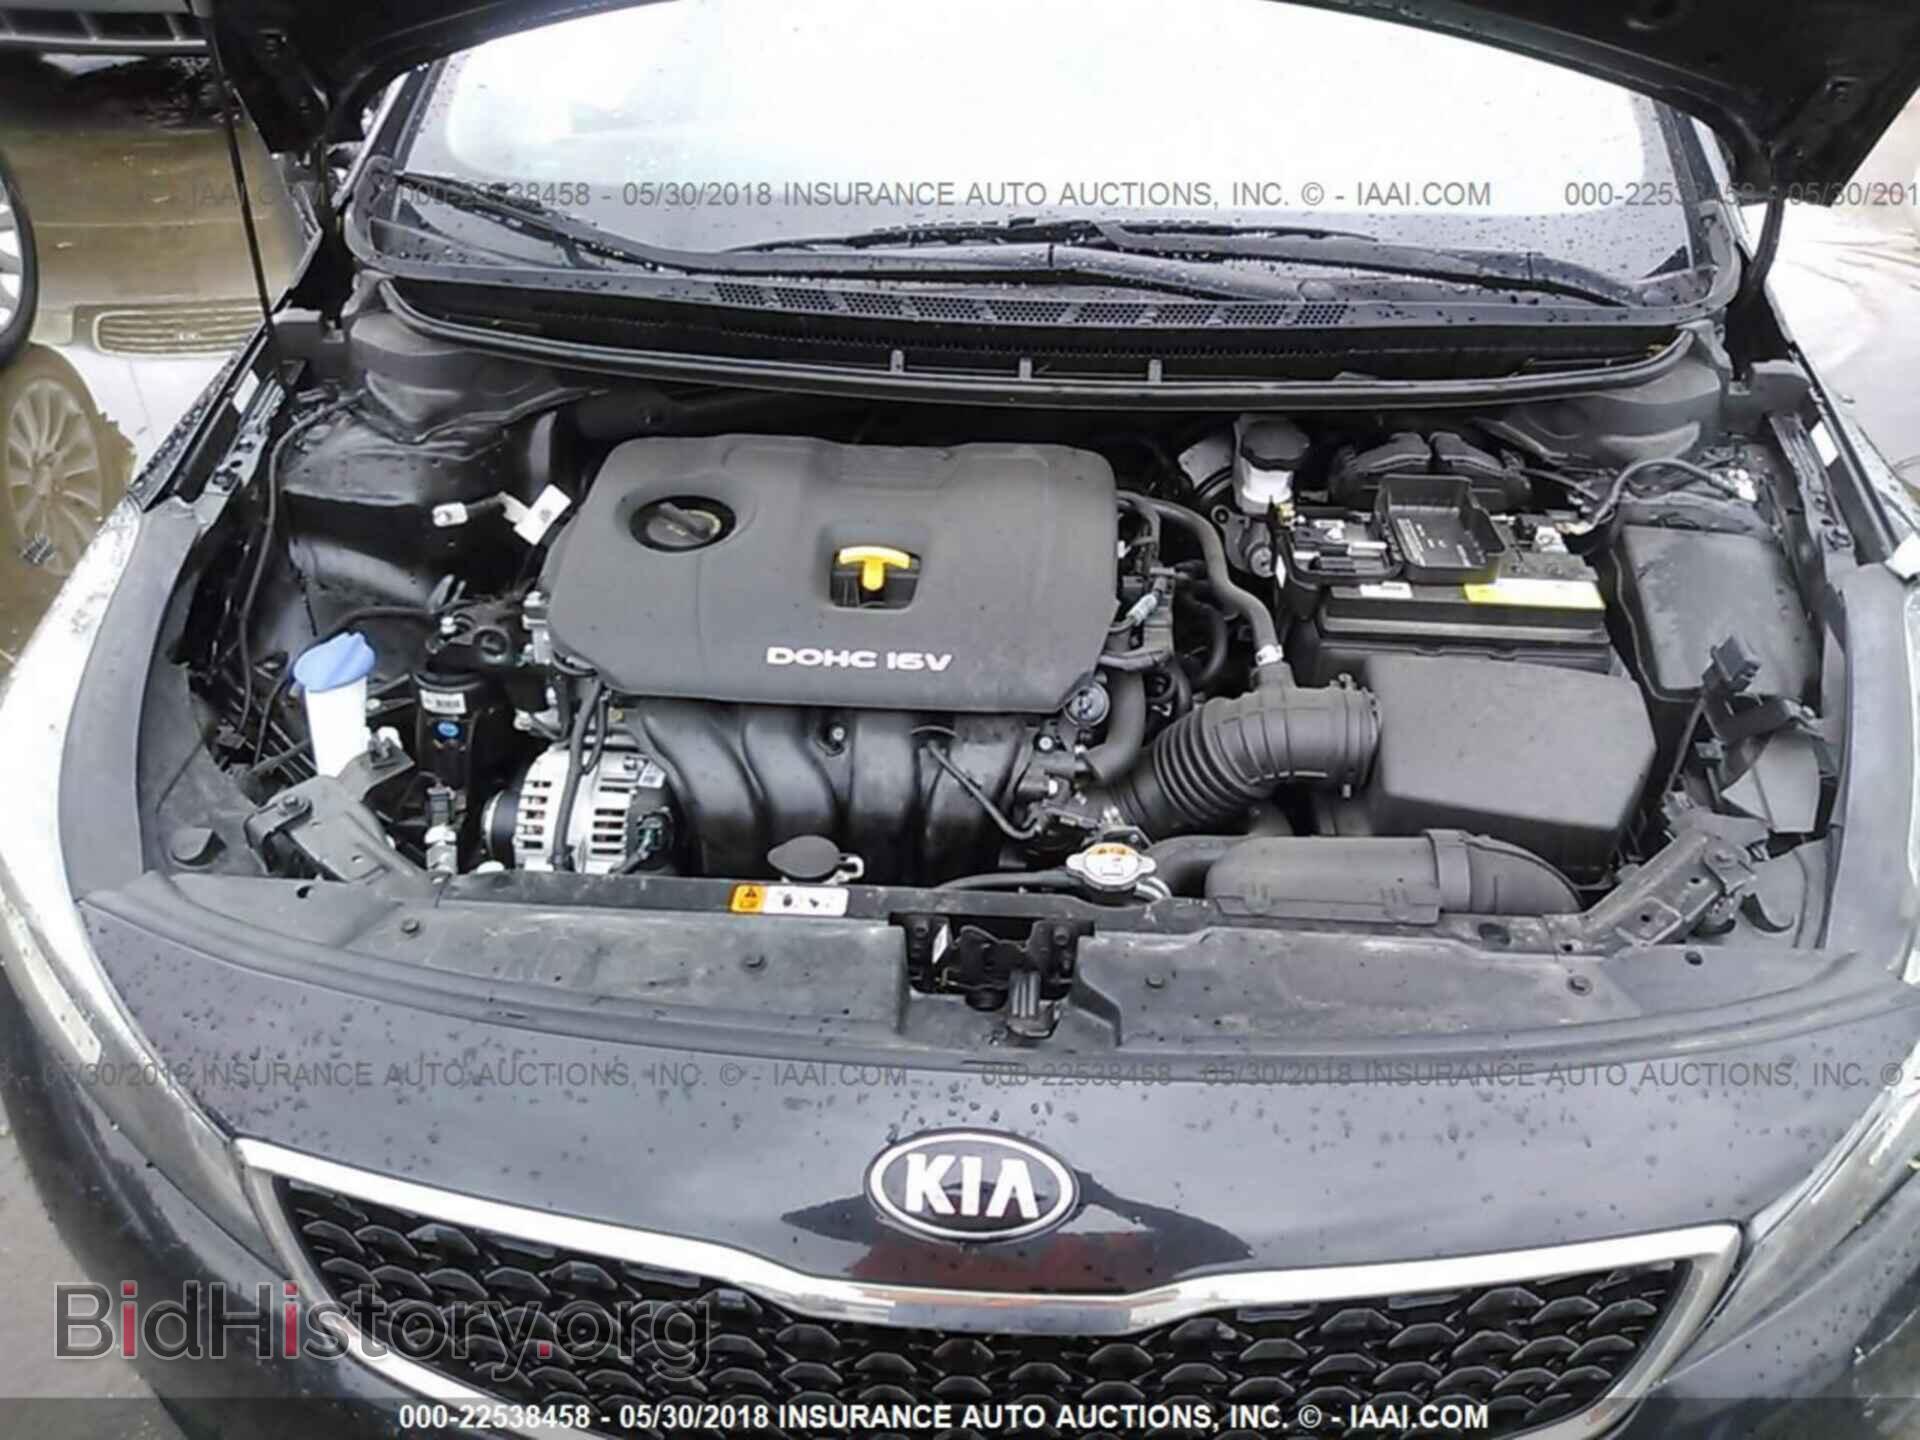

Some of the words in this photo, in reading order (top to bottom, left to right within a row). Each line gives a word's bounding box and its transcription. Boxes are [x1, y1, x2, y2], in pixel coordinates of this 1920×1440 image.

[766, 646, 877, 669] DOHC
[886, 652, 953, 672] 16V
[905, 1152, 1040, 1219] KIA
